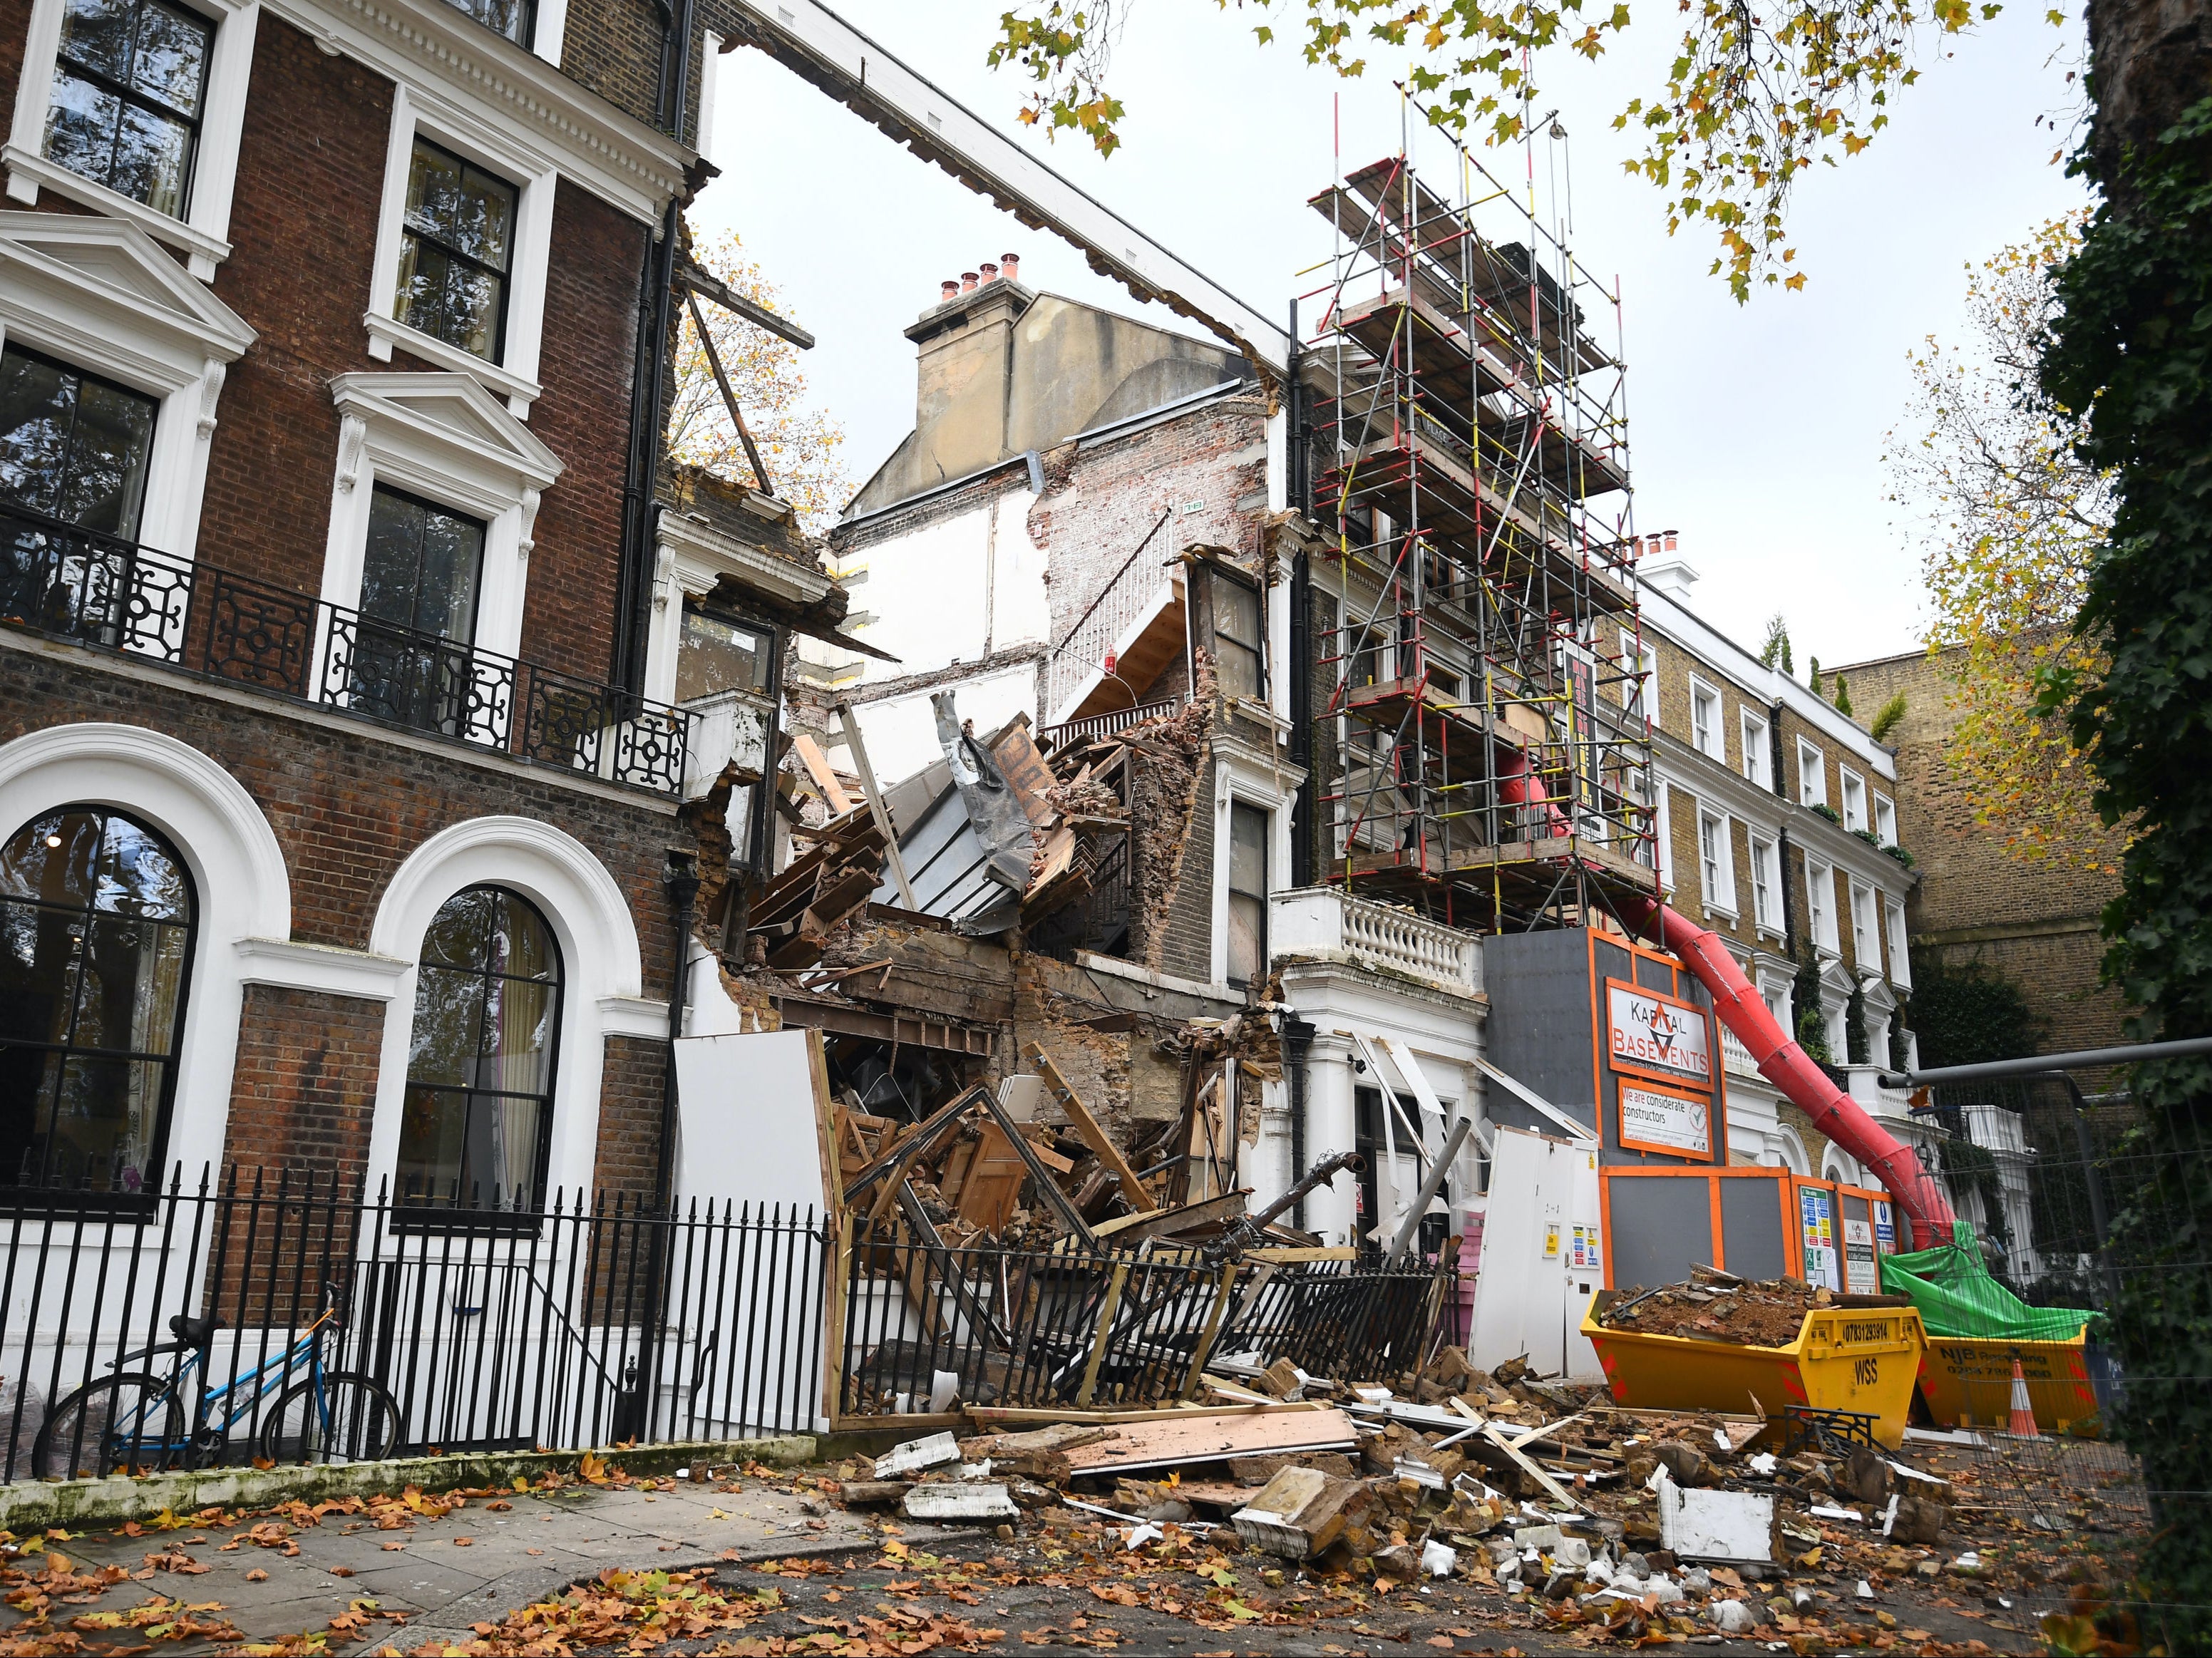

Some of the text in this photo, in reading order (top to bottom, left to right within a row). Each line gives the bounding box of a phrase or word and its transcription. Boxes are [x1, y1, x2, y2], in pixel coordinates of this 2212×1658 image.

[1426, 419, 1448, 443] PLACE
[1630, 1000, 1687, 1035] KAPITAL
[1612, 1027, 1708, 1072] BASEMENTS
[1622, 1086, 1685, 1113] We are considerate
[1622, 1106, 1666, 1124] constructors
[1845, 1322, 1888, 1342] 07831293914
[1855, 1358, 1878, 1386] WSS
